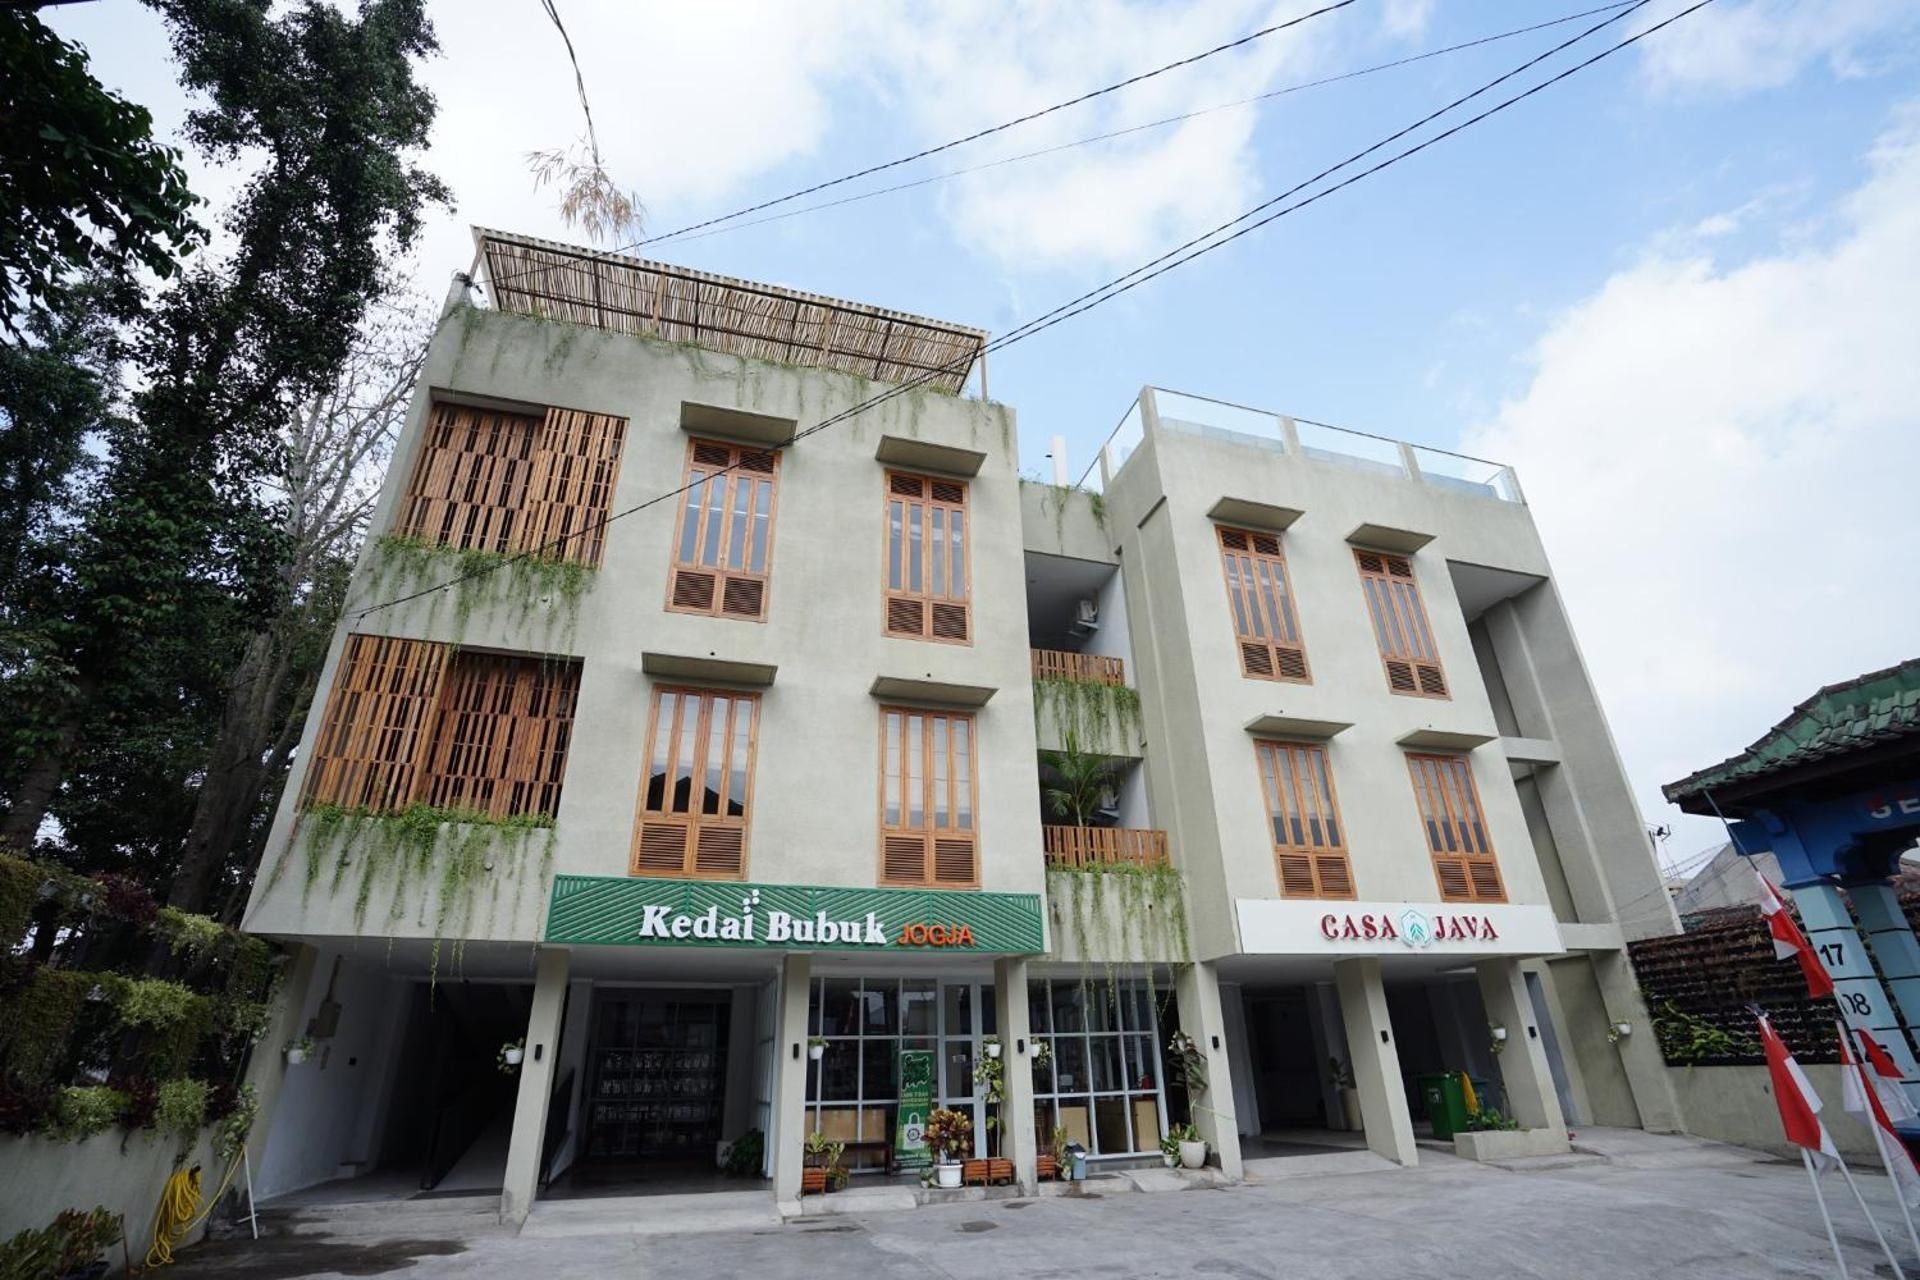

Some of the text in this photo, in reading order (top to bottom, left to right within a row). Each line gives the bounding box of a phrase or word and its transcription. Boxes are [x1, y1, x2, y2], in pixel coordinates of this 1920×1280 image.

[639, 904, 975, 946] Kedai Bubuk JOGJA
[1321, 914, 1500, 939] CASA JAVA
[1820, 943, 1844, 967] 17
